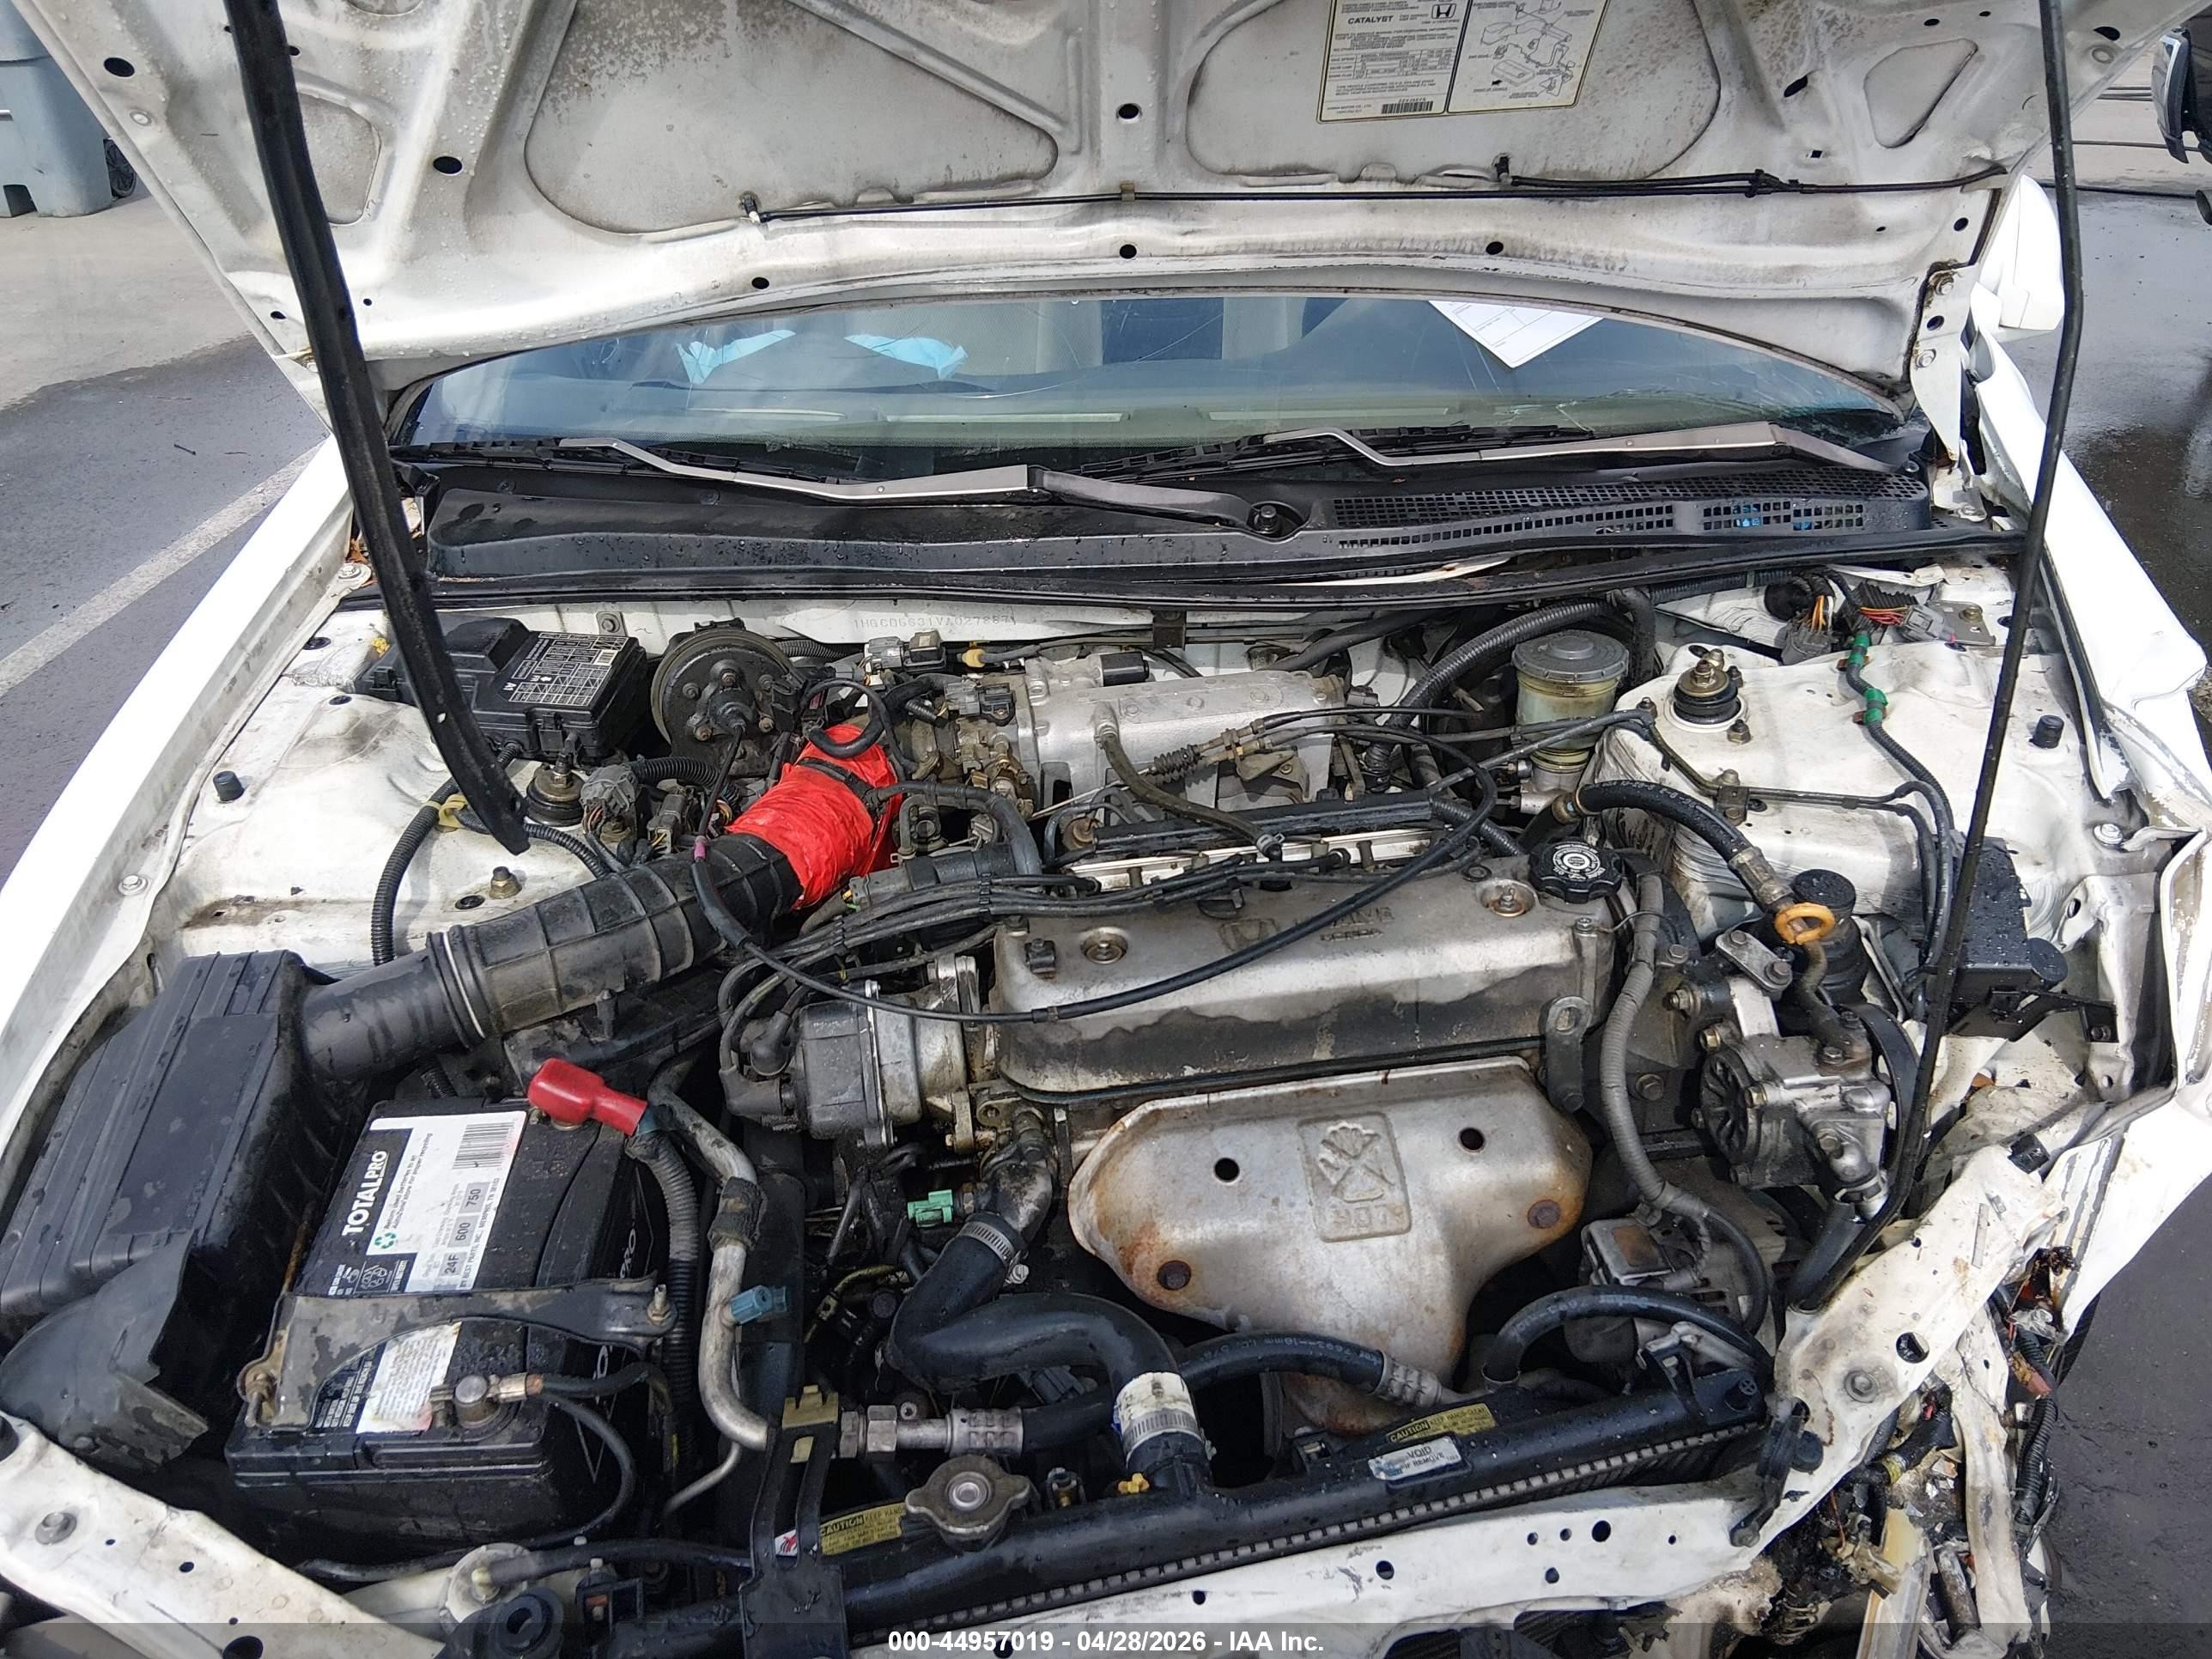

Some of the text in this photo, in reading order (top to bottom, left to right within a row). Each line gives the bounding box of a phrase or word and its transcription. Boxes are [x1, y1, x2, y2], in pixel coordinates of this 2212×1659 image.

[1347, 15, 1394, 25] CATALYST
[342, 1151, 387, 1237] TOTALPRO
[465, 1188, 482, 1208] 750
[455, 1222, 471, 1242] 600
[444, 1254, 459, 1273] 24F
[1389, 1421, 1429, 1443] CAUTION
[1407, 1445, 1432, 1458] VOID
[1413, 1451, 1444, 1467] REMOVE
[820, 1513, 864, 1536] CAUTION
